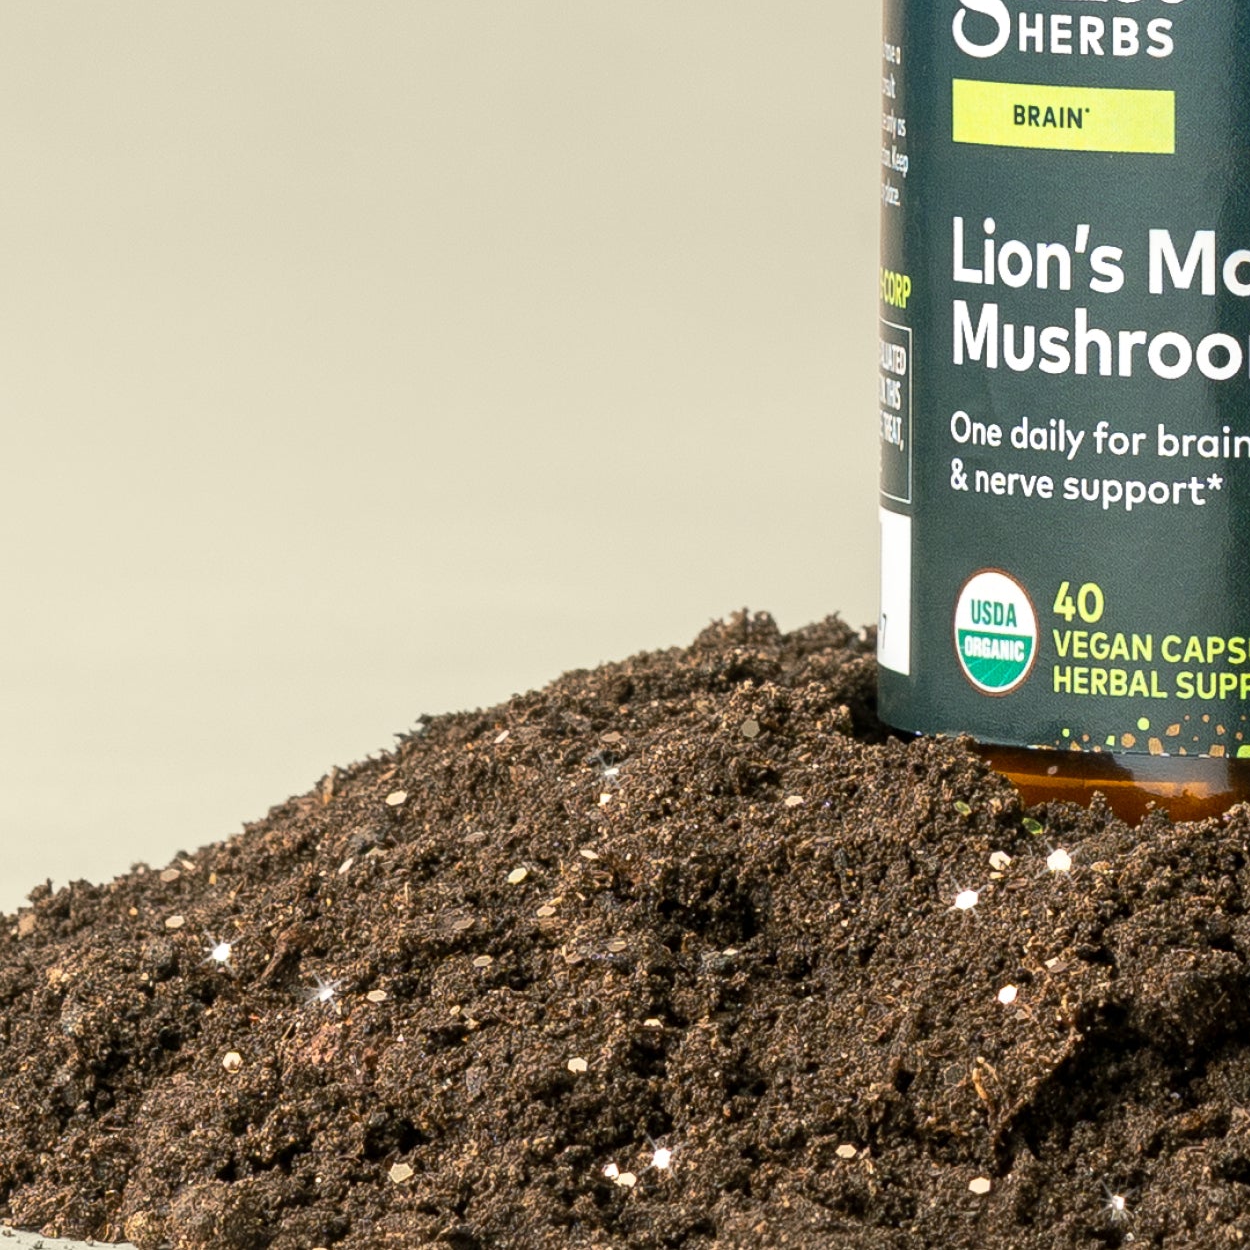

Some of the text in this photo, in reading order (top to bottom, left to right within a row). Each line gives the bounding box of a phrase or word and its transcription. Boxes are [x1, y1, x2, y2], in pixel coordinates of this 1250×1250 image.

[1018, 12, 1174, 58] HERBS
[953, 216, 1125, 294] Lion's
[950, 410, 1003, 447] One
[1010, 416, 1085, 461] daily
[1092, 420, 1147, 456] for
[950, 457, 969, 491] &
[975, 469, 1054, 499] nerve
[970, 598, 1018, 628] USDA
[1053, 581, 1105, 623] 40
[963, 634, 1026, 663] ORGANIC
[1052, 629, 1153, 662] VEGAN
[1053, 665, 1168, 699] HERBAL
